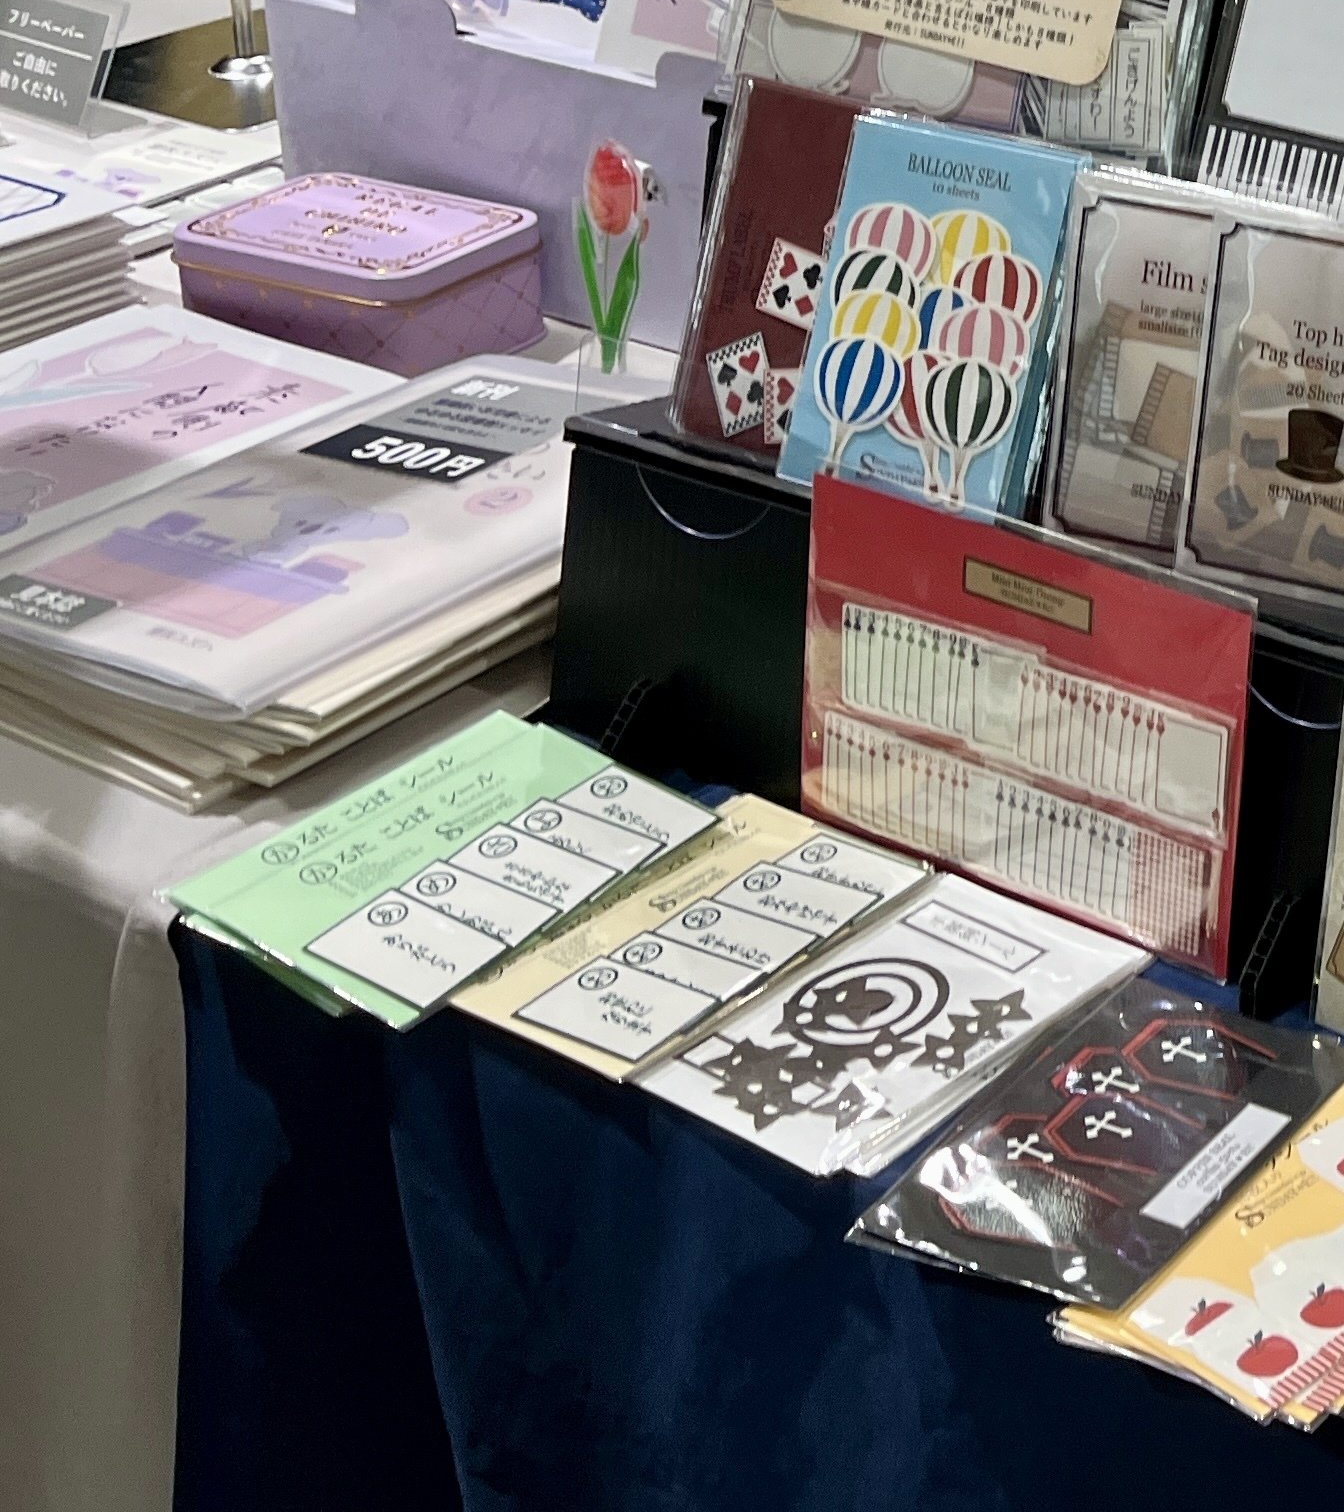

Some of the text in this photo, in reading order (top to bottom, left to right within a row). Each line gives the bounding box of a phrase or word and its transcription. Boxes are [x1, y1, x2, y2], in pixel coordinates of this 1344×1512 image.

[9, 9, 86, 40] フリーペーパー
[907, 151, 1012, 193] BALLOON SEAL
[946, 185, 980, 202] sheets
[1140, 258, 1195, 293] Film
[1293, 319, 1329, 348] Top
[1256, 340, 1290, 370] Tag
[1286, 381, 1306, 400] 20
[351, 434, 488, 482] 500円
